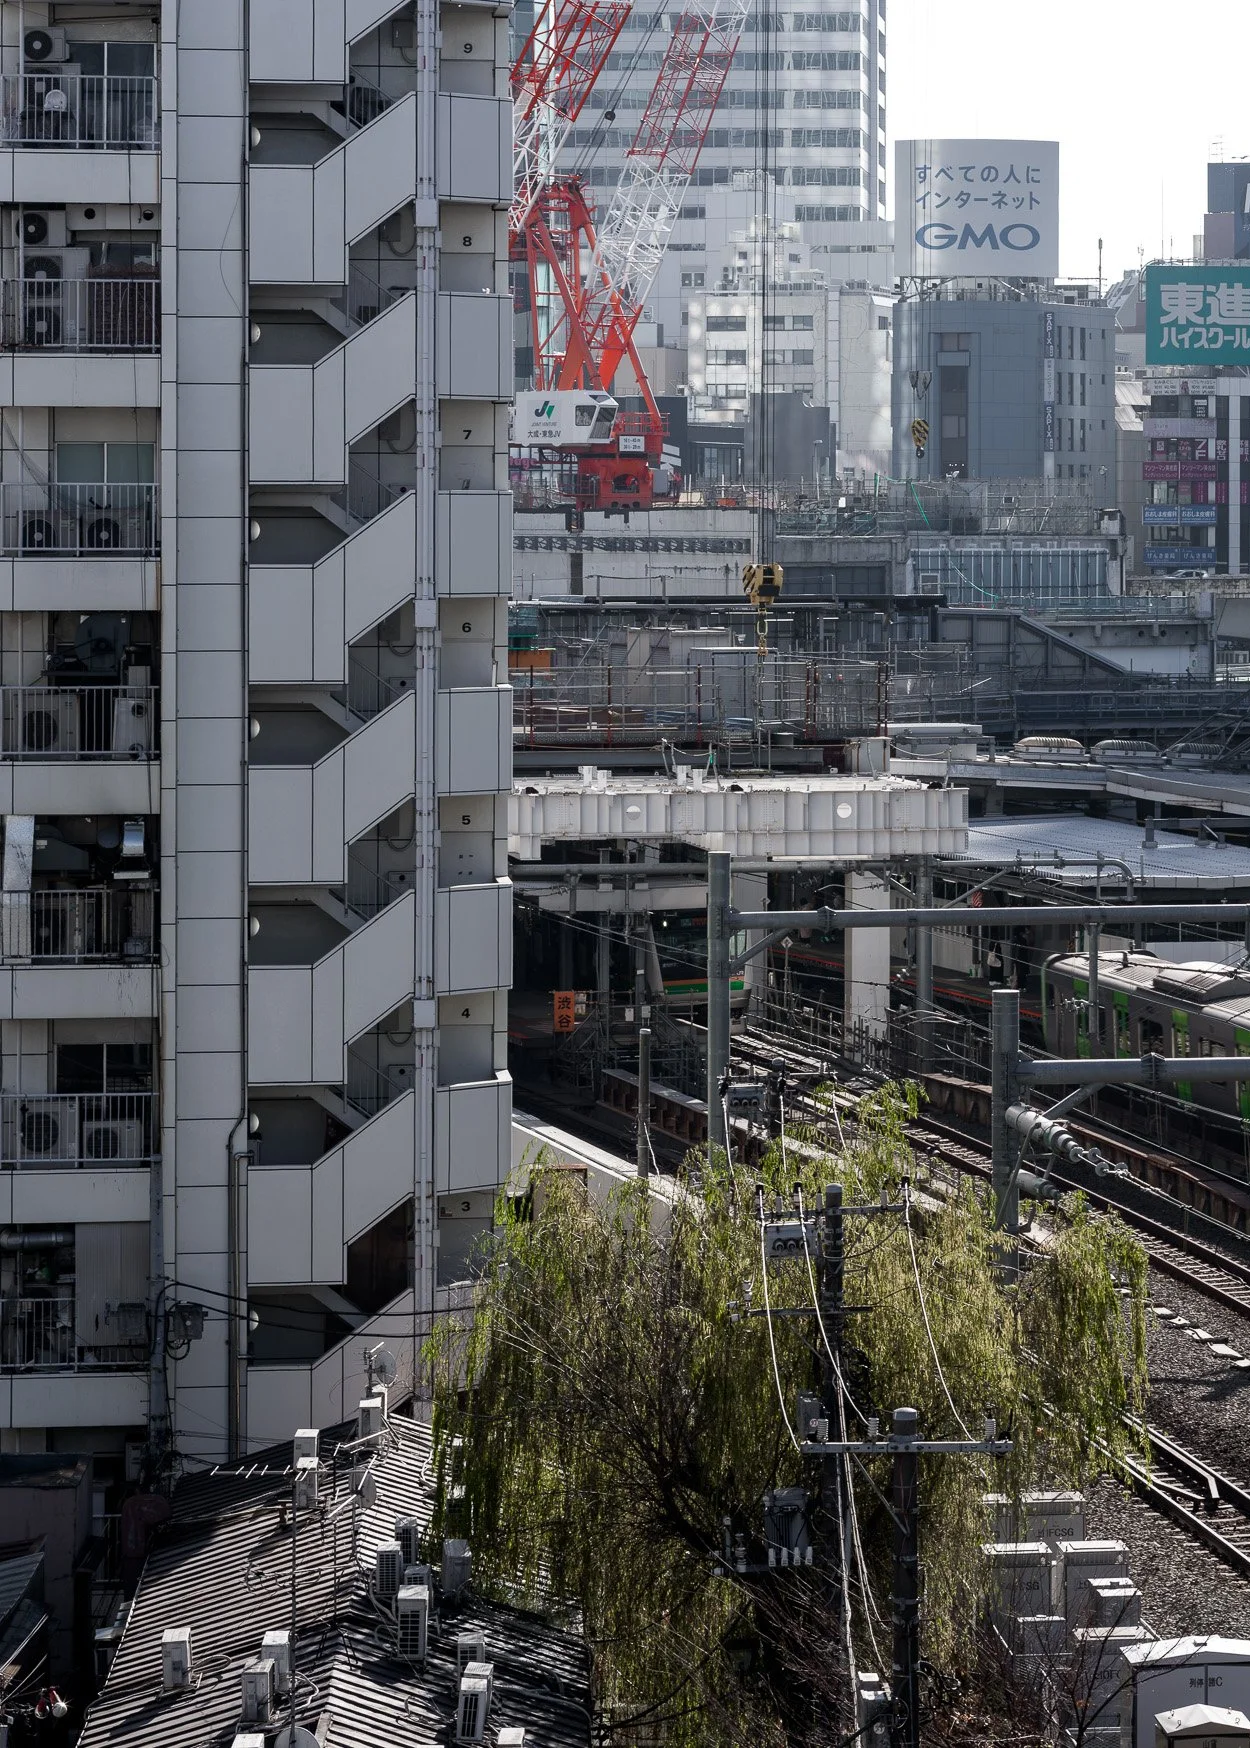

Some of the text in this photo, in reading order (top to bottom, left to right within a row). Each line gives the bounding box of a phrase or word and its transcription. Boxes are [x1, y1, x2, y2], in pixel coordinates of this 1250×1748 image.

[463, 43, 473, 53] 9
[915, 164, 1041, 184] すべての人に
[916, 190, 1041, 210] インターネット
[463, 236, 472, 246] 8
[915, 223, 1041, 250] GMO
[463, 430, 471, 439] 7
[462, 623, 471, 632] 6
[461, 815, 471, 825] 5
[462, 1008, 470, 1018] 4
[558, 996, 571, 1028] 渋谷
[461, 1201, 470, 1211] 3
